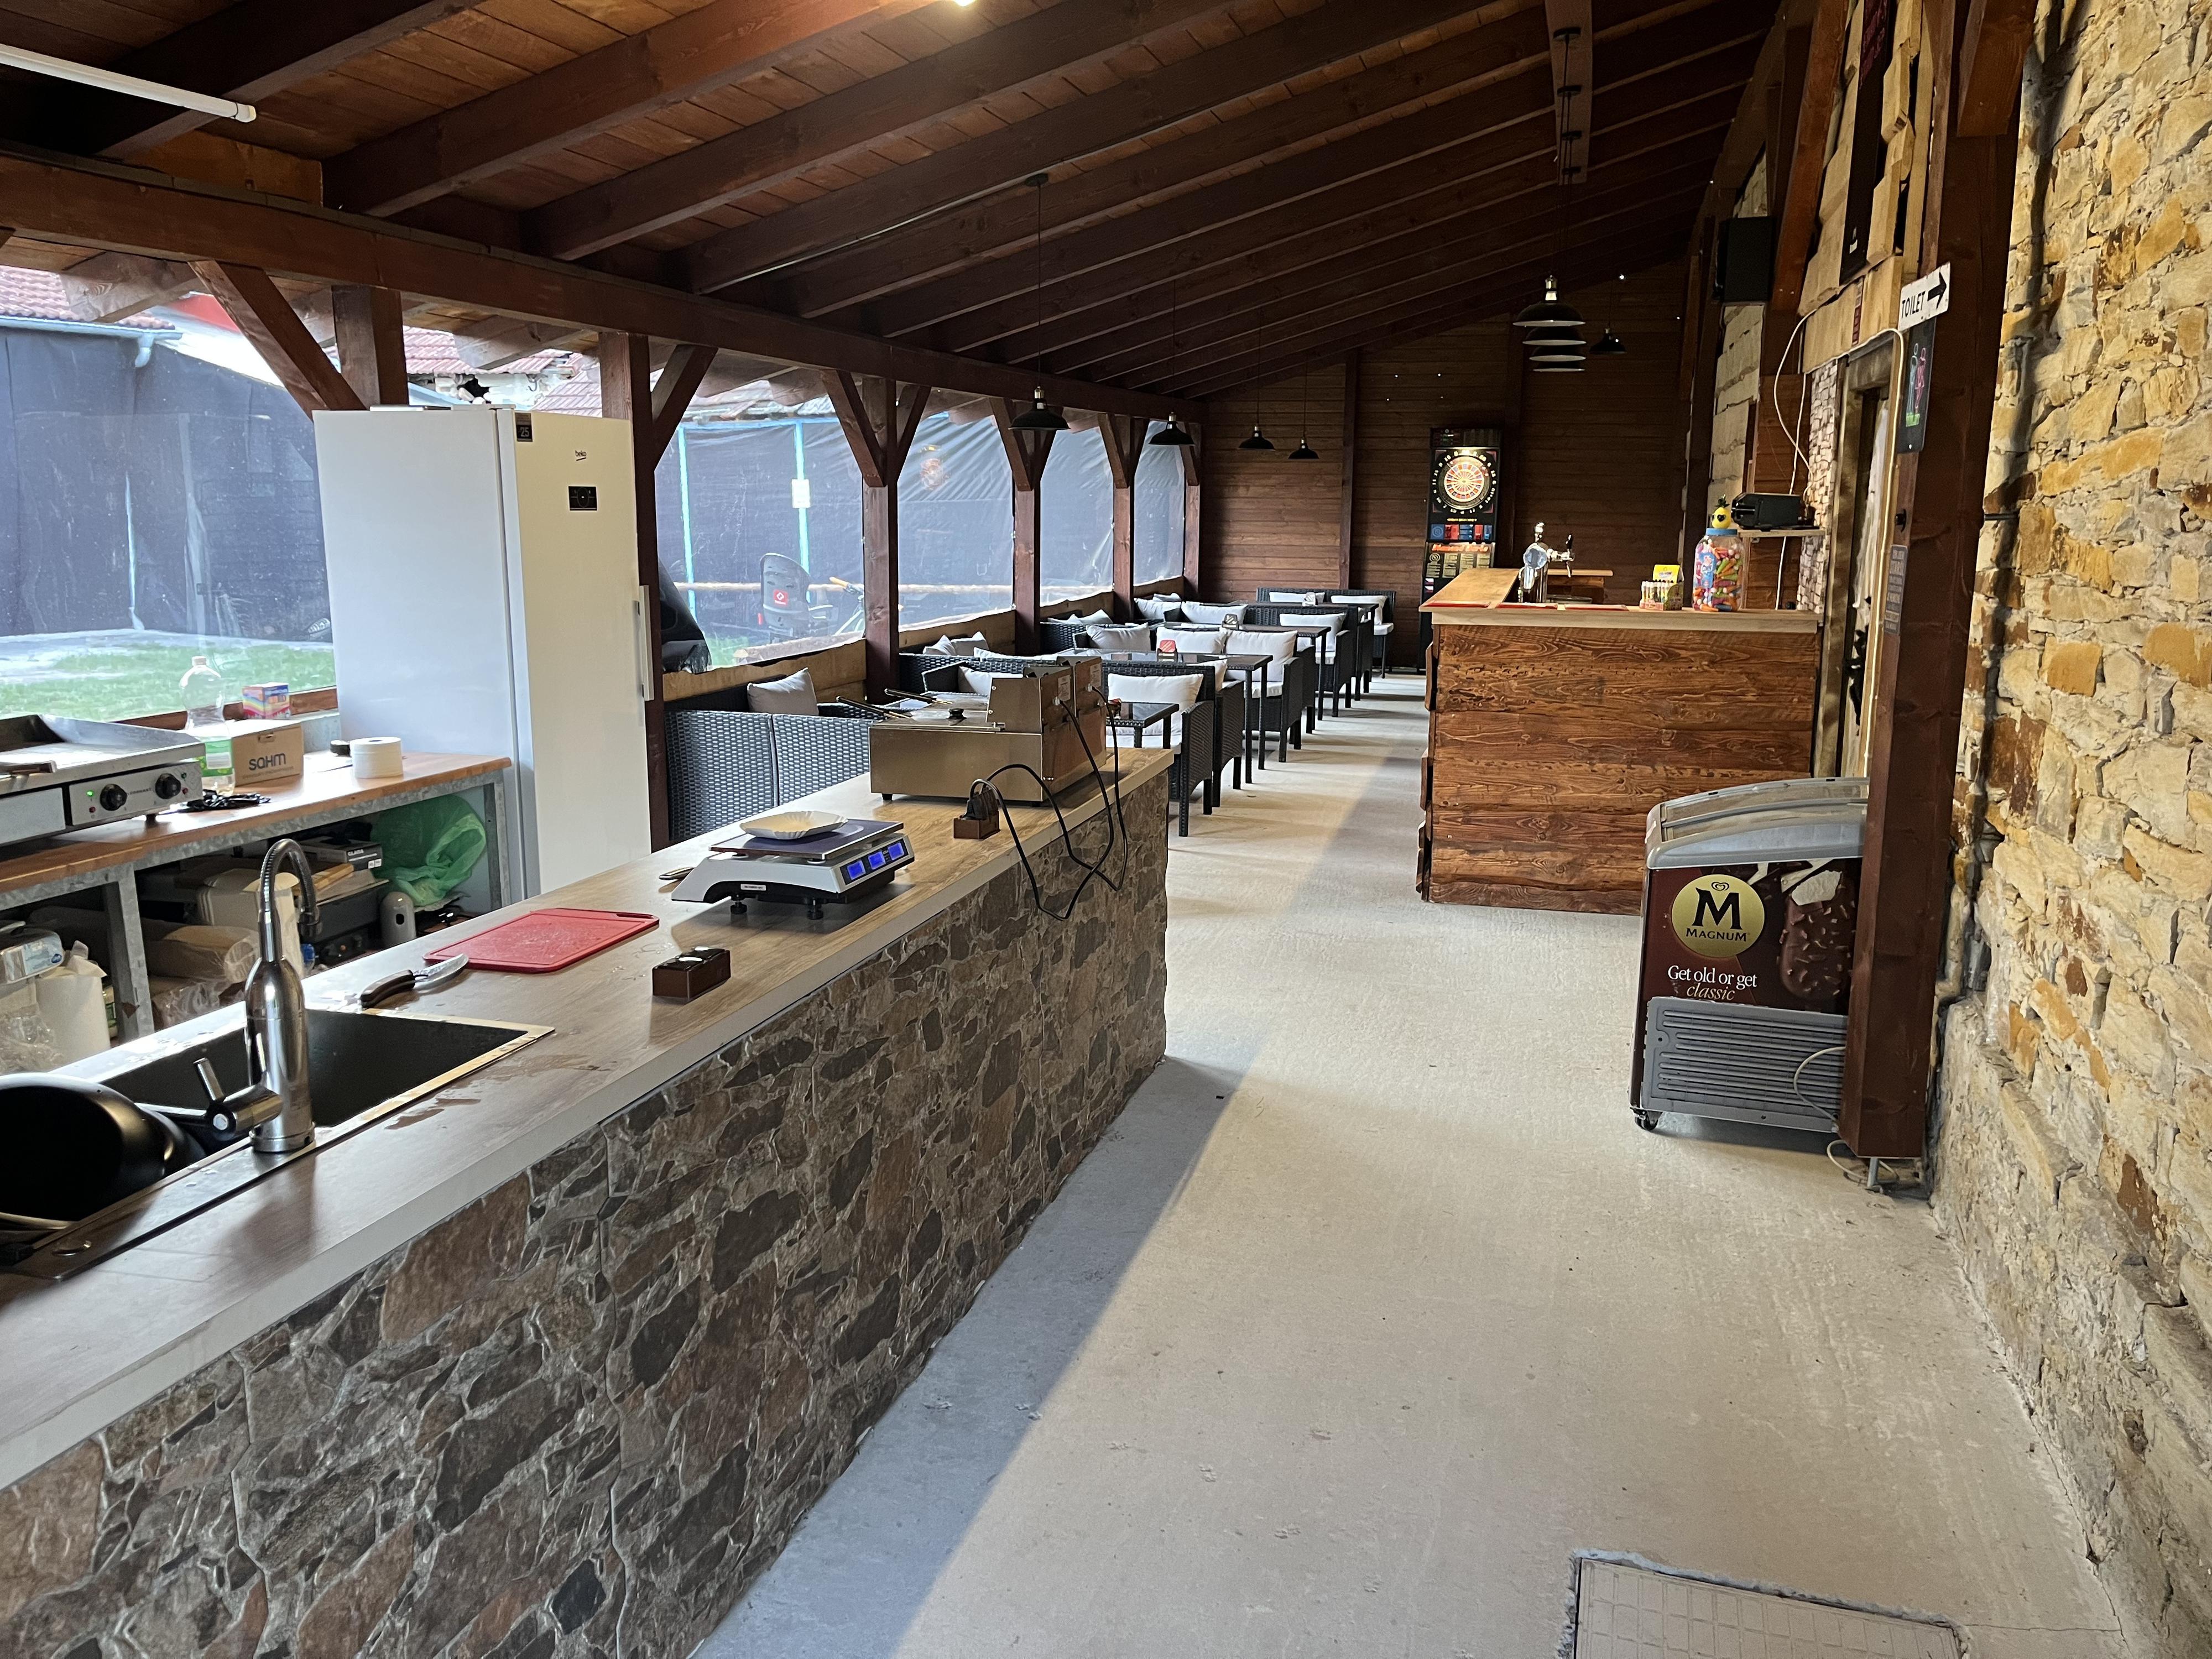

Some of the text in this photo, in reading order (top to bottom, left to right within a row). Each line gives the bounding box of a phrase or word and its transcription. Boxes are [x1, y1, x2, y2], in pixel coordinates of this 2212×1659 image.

[1902, 291, 1926, 319] TOILET
[1692, 887, 1743, 930] M
[1686, 928, 1747, 942] MAGNUM
[1668, 965, 1757, 990] Get old or get
[1687, 983, 1735, 1000] classic
